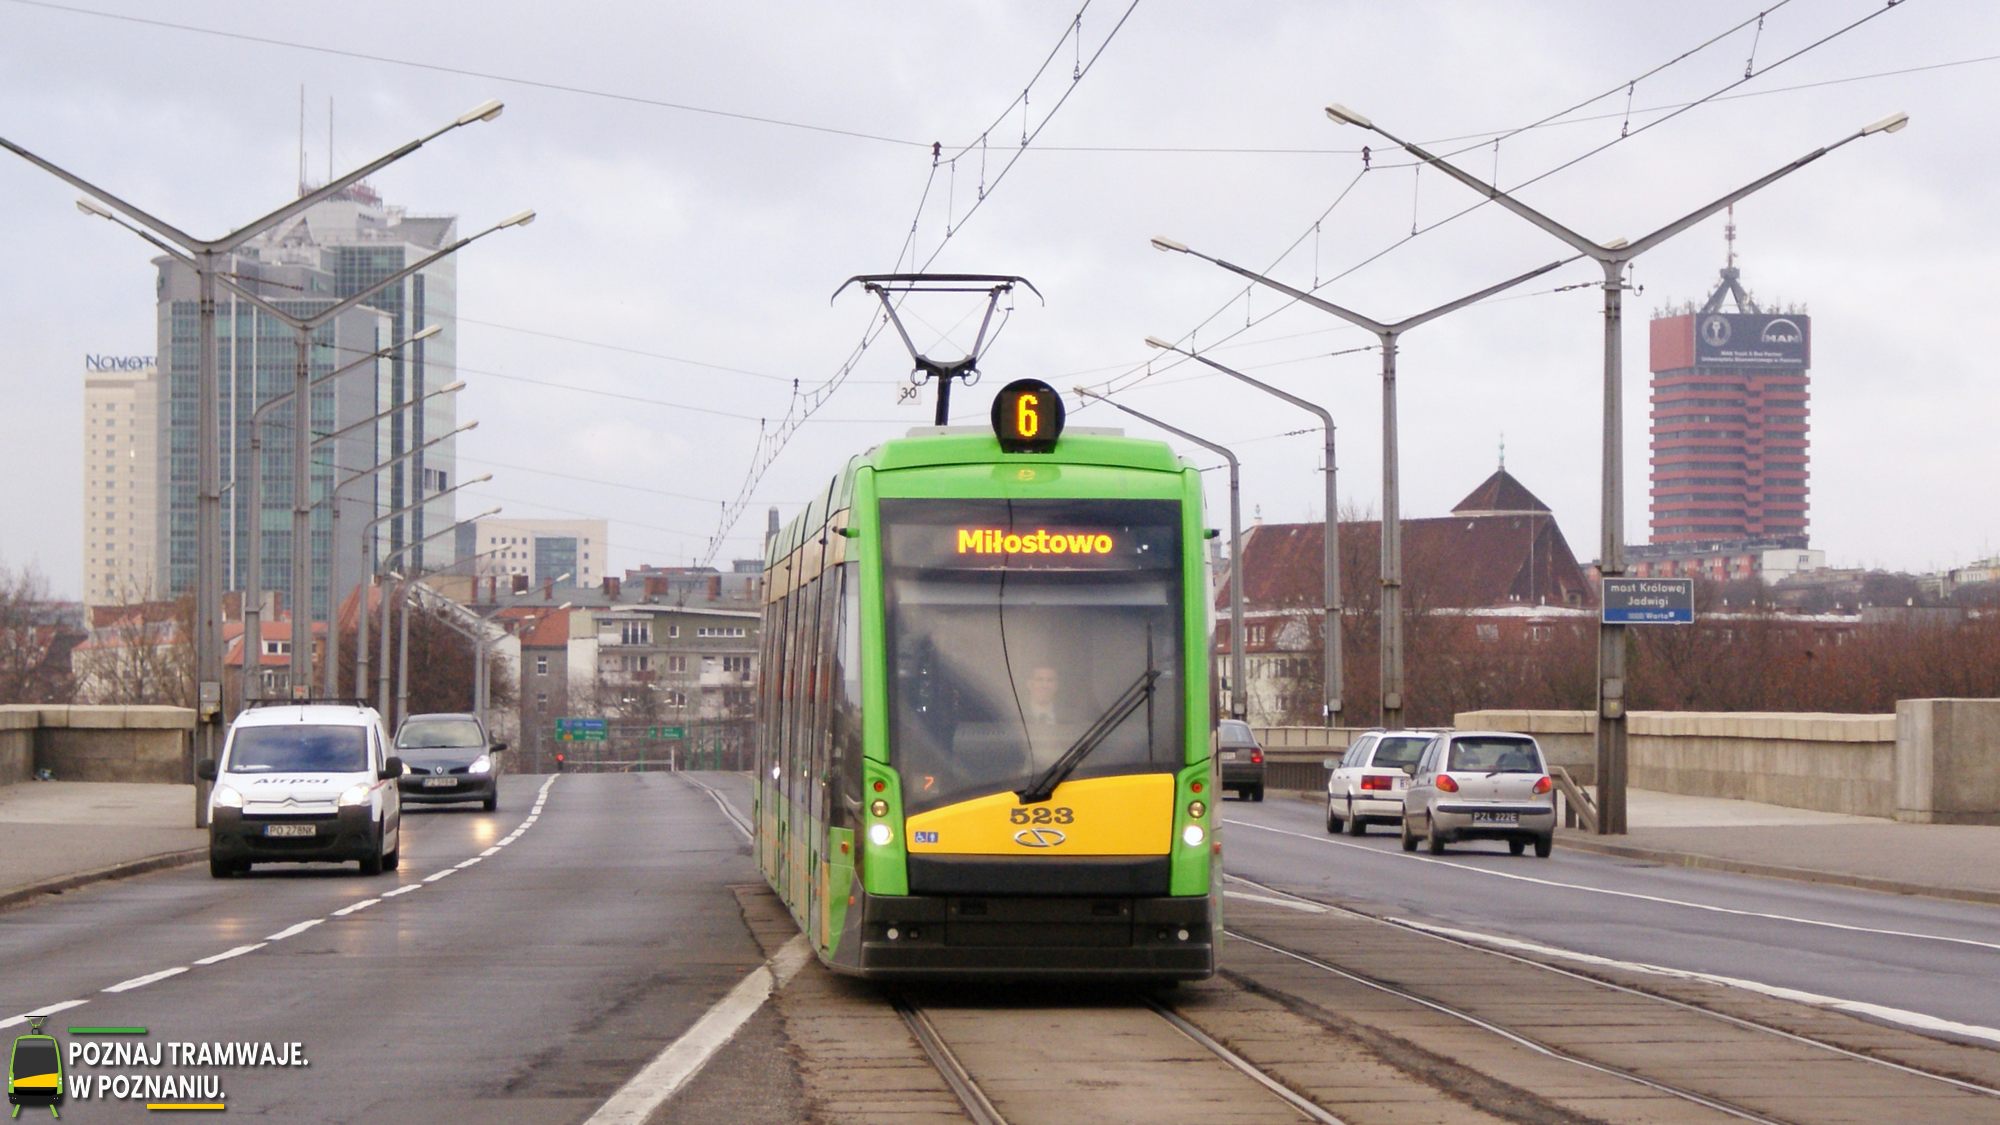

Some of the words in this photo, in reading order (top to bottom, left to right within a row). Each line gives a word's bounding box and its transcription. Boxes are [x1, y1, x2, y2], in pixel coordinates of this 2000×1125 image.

[1765, 334, 1800, 343] MAN
[1017, 394, 1039, 437] 6
[958, 529, 1113, 554] Miłostowo
[1610, 583, 1636, 593] most
[1639, 582, 1686, 595] Królowej
[1627, 597, 1669, 608] Jadwigi
[1009, 807, 1075, 825] 523
[1474, 812, 1492, 821] PZL
